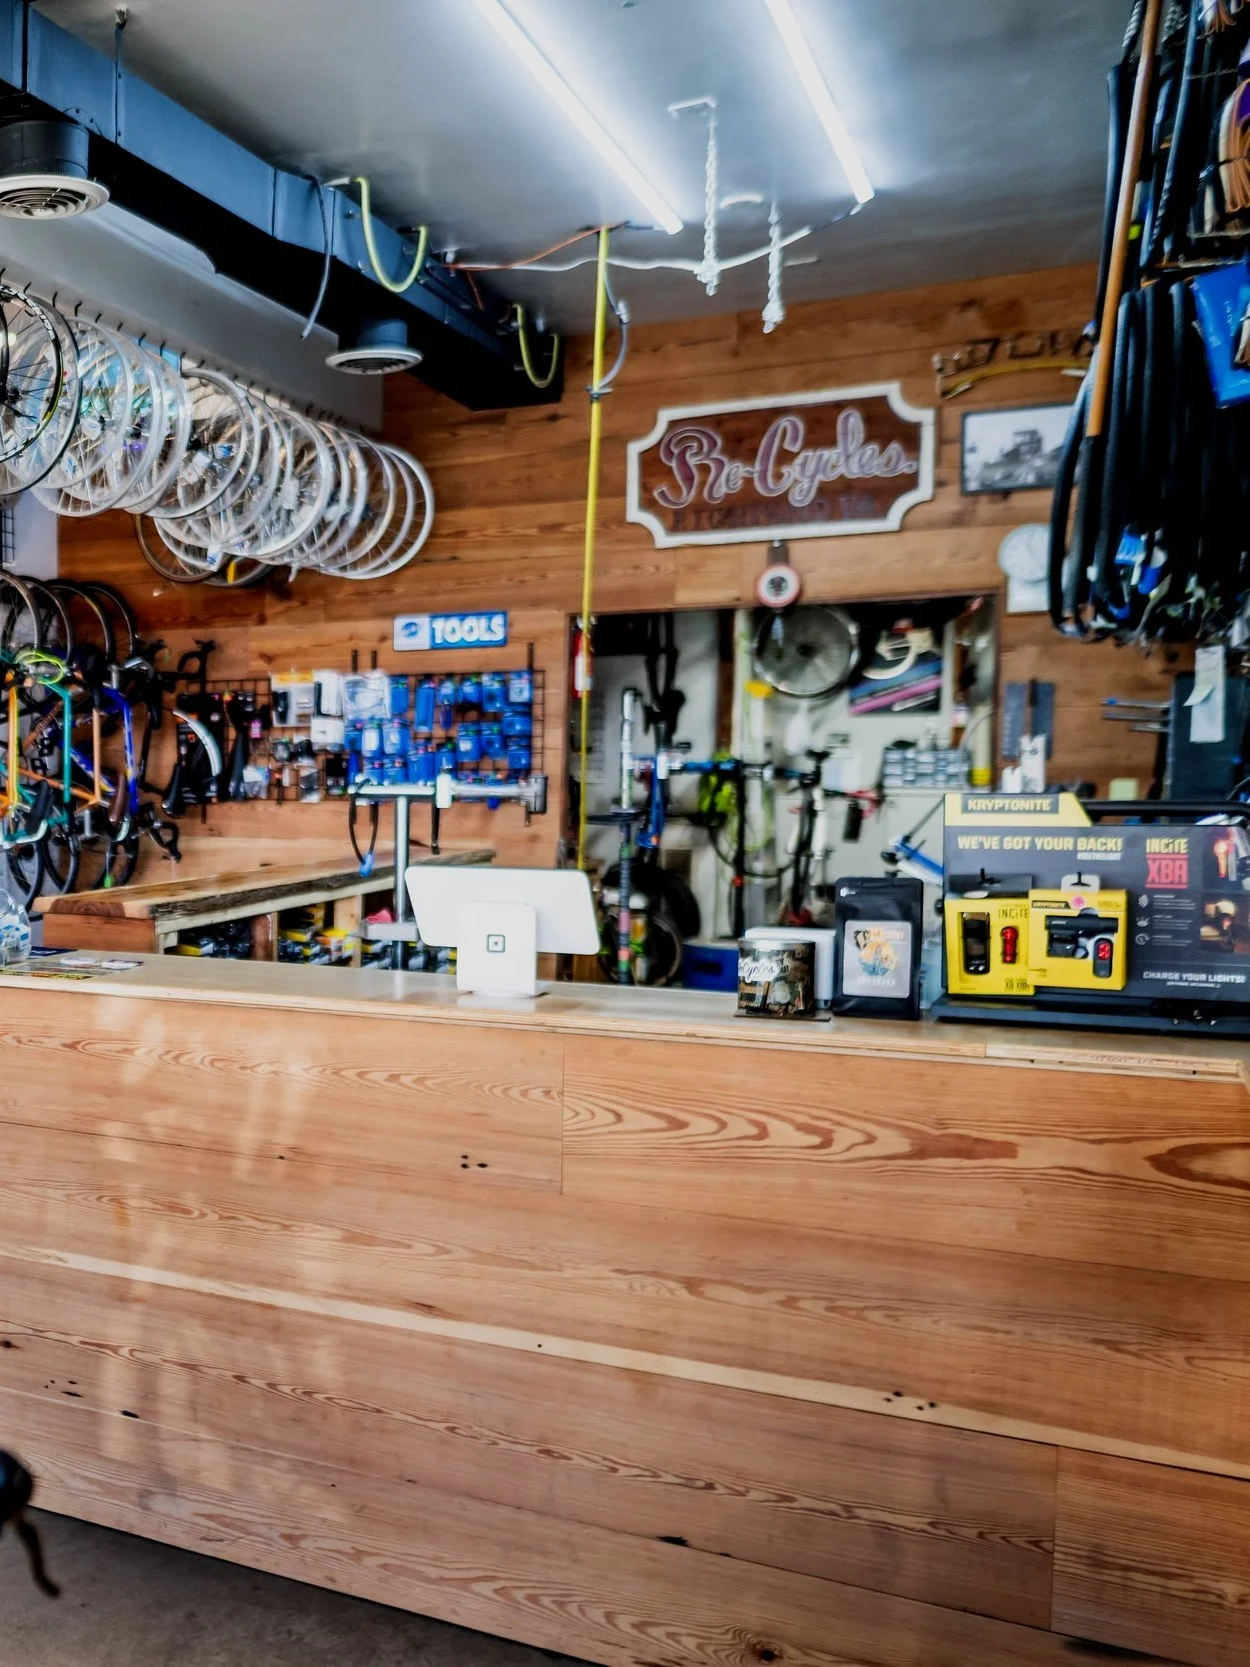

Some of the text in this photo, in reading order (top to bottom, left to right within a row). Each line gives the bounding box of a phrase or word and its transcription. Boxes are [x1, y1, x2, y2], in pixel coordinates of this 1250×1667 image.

[432, 614, 505, 644] TOOLS
[967, 798, 1052, 811] KRYPTONITE
[957, 835, 1123, 852] WE'VE GOT YOUR BACK!
[1146, 859, 1188, 884] XBR
[1143, 971, 1180, 981] CHARGE
[1182, 973, 1206, 982] YOUR
